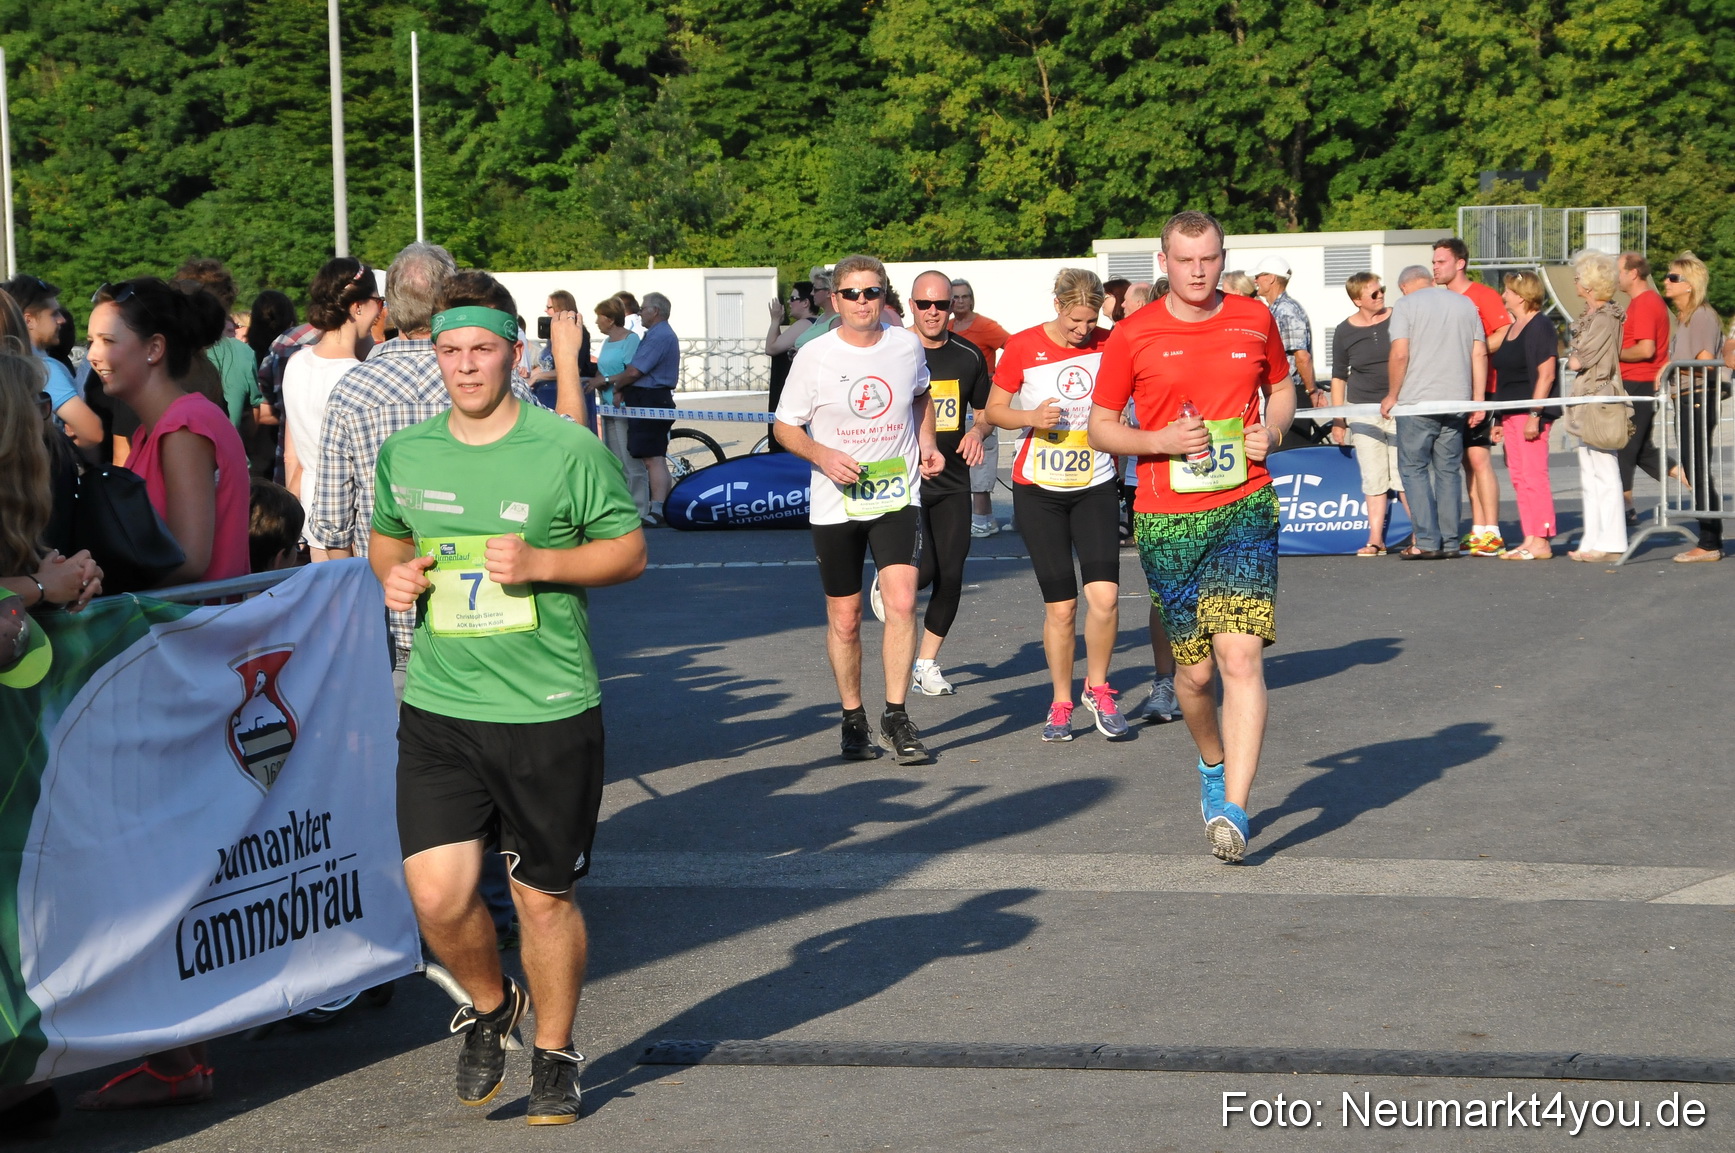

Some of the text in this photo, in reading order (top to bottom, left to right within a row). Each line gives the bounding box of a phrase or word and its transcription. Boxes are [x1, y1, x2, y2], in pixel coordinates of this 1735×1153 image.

[1036, 449, 1091, 472] 1028
[711, 487, 811, 521] Fischer
[846, 477, 906, 502] 1023
[460, 572, 484, 611] 7
[176, 858, 363, 981] Lammsbräu
